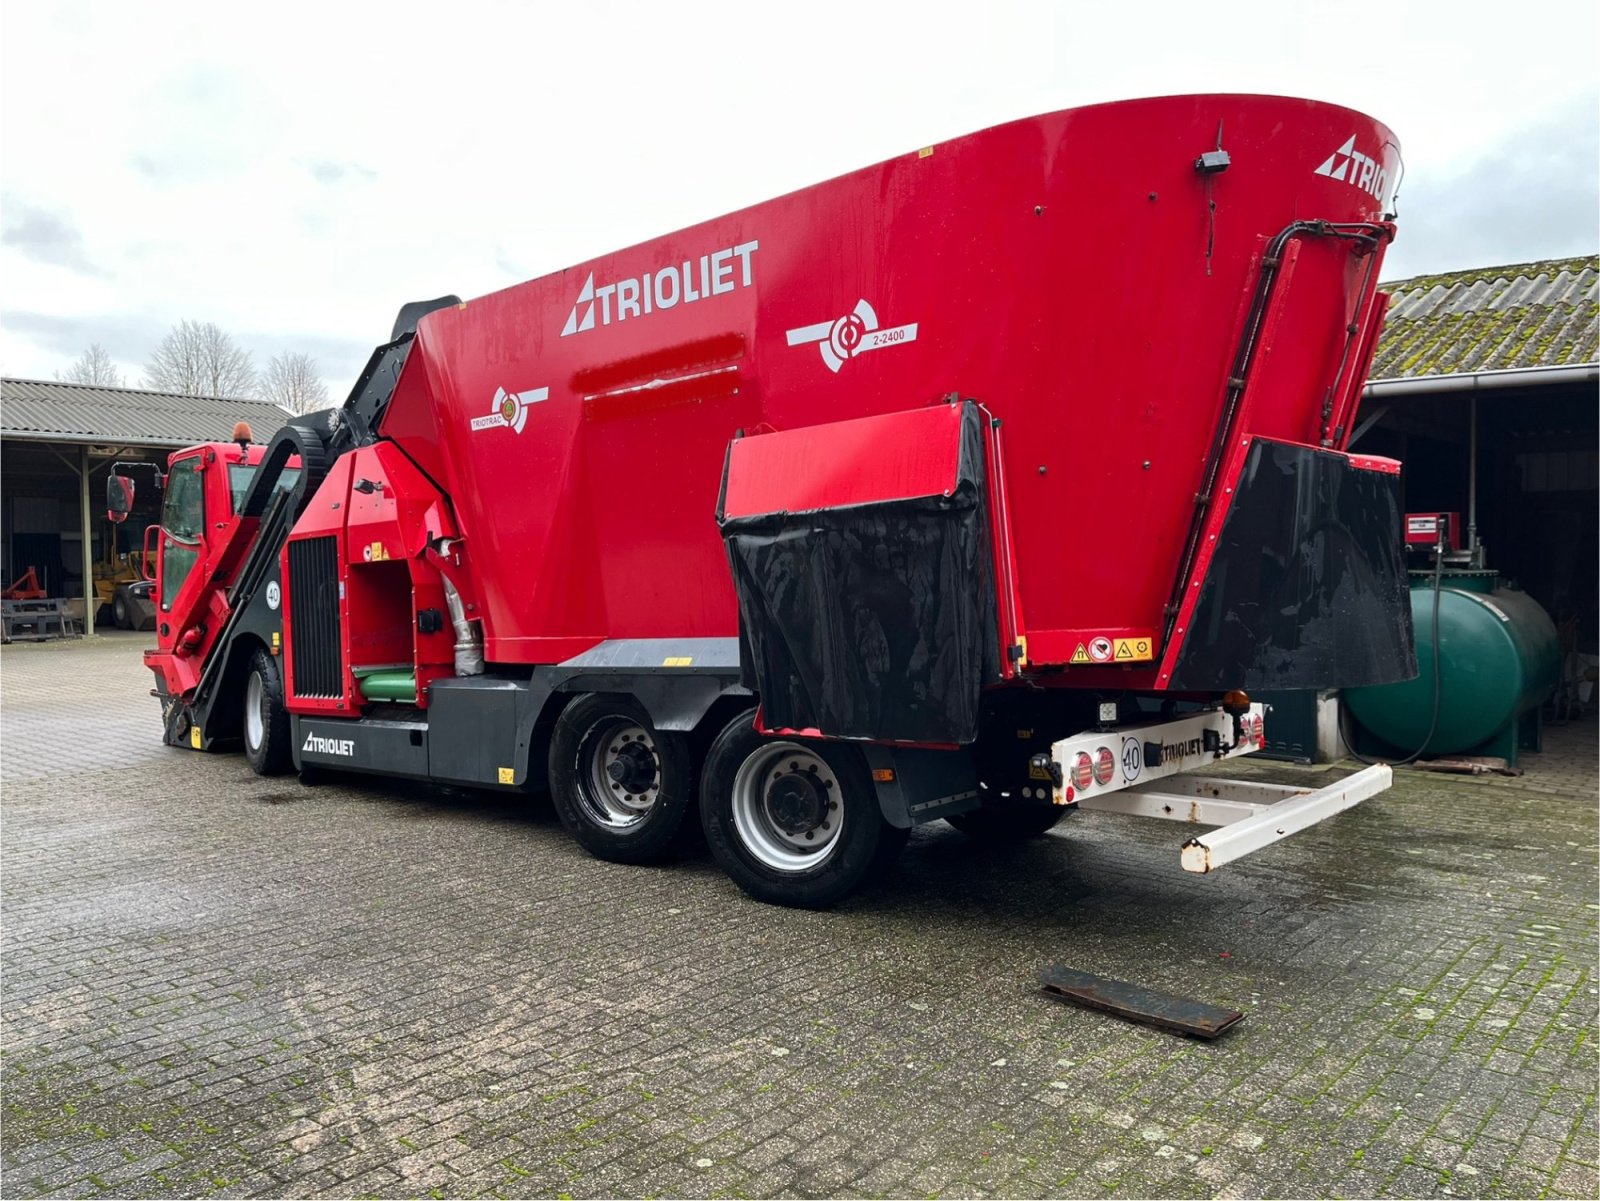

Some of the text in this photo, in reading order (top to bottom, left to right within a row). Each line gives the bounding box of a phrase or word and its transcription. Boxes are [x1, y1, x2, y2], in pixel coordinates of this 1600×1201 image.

[596, 240, 758, 325] TRIOLIET
[873, 329, 905, 346] 2-2400
[472, 415, 502, 429] TRIOTRAC
[268, 587, 279, 602] 40
[312, 736, 355, 756] TRIOLIET
[1123, 746, 1140, 771] 40
